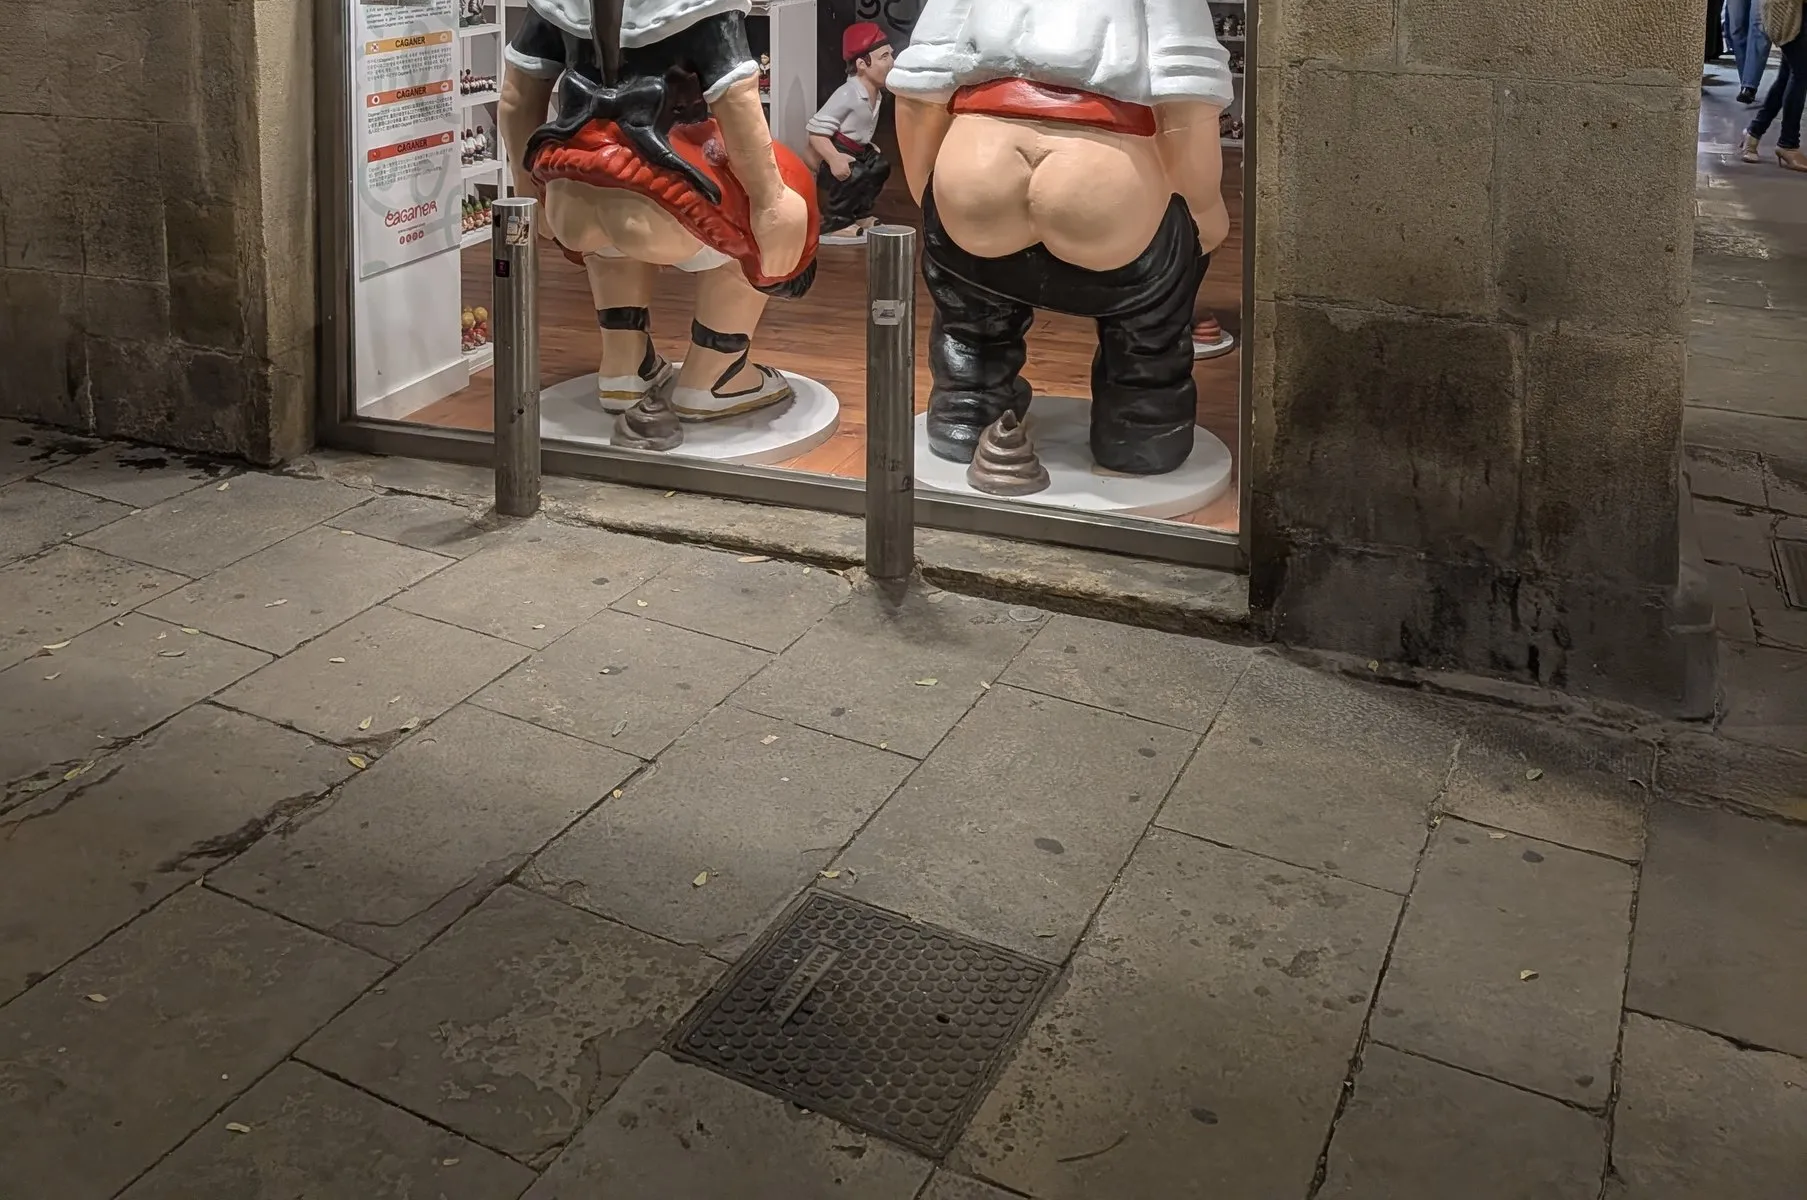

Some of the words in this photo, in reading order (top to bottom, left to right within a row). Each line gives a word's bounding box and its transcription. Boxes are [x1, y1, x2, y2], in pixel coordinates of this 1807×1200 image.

[395, 36, 426, 48] CAGANER
[396, 86, 427, 99] CAGANER
[397, 139, 428, 153] CAGANER
